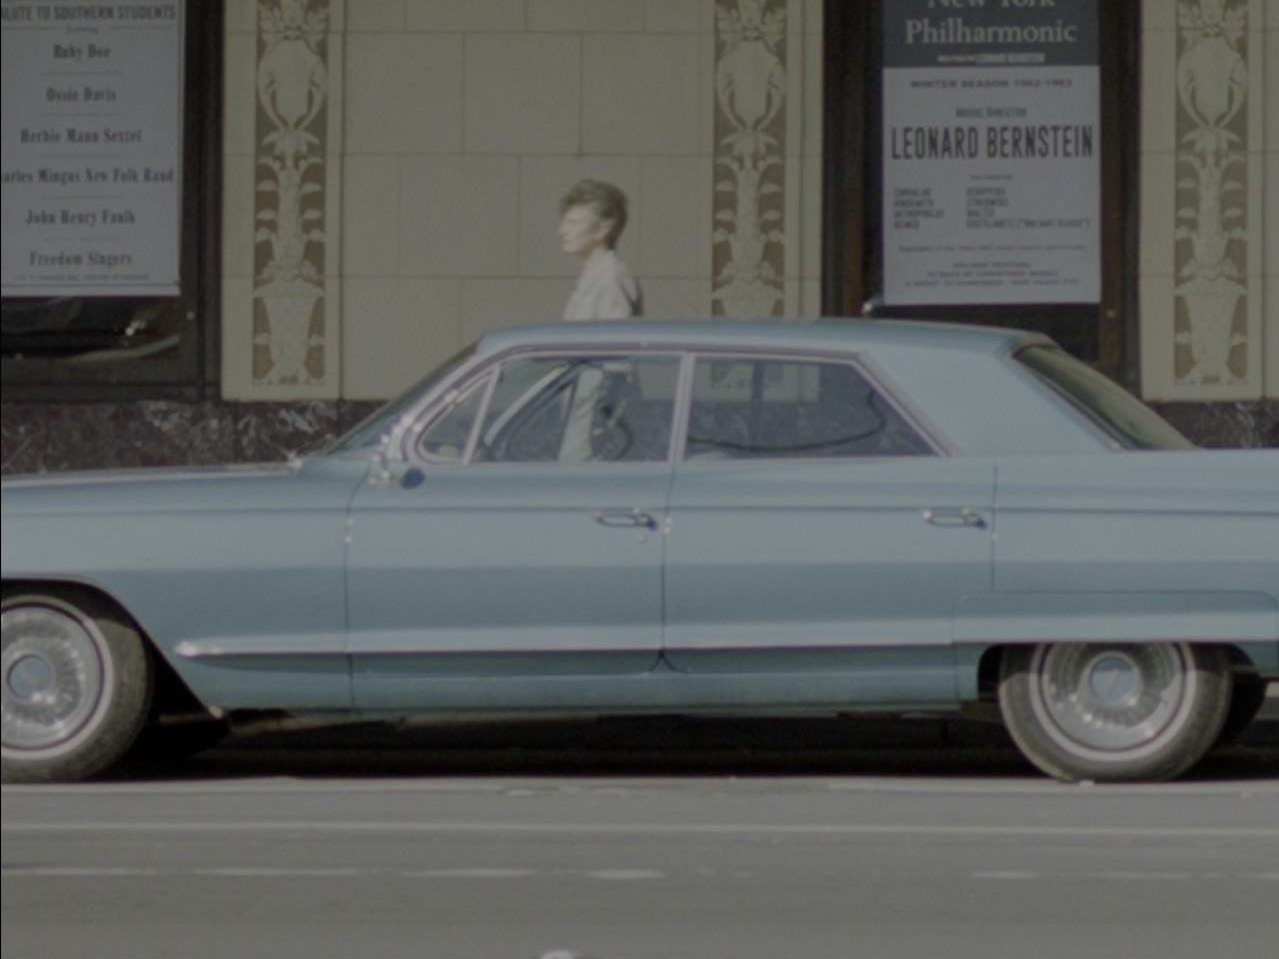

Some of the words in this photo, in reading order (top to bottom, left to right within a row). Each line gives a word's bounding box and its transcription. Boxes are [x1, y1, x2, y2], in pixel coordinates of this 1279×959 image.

[37, 5, 50, 20] TO
[54, 5, 114, 21] SOUTHERN
[118, 5, 175, 20] STUDENTS
[905, 17, 1078, 44] Philharmonic
[46, 87, 78, 102] Ossie
[84, 87, 117, 102] Davis
[66, 129, 99, 143] Mann
[891, 126, 979, 159] LEONARD
[987, 125, 1093, 158] BERNSTEIN
[38, 169, 80, 186] Mingus
[113, 169, 138, 182] Folk
[143, 168, 173, 183] Band
[25, 210, 55, 225] John
[29, 252, 82, 266] Freedom
[87, 251, 133, 267] Singers
